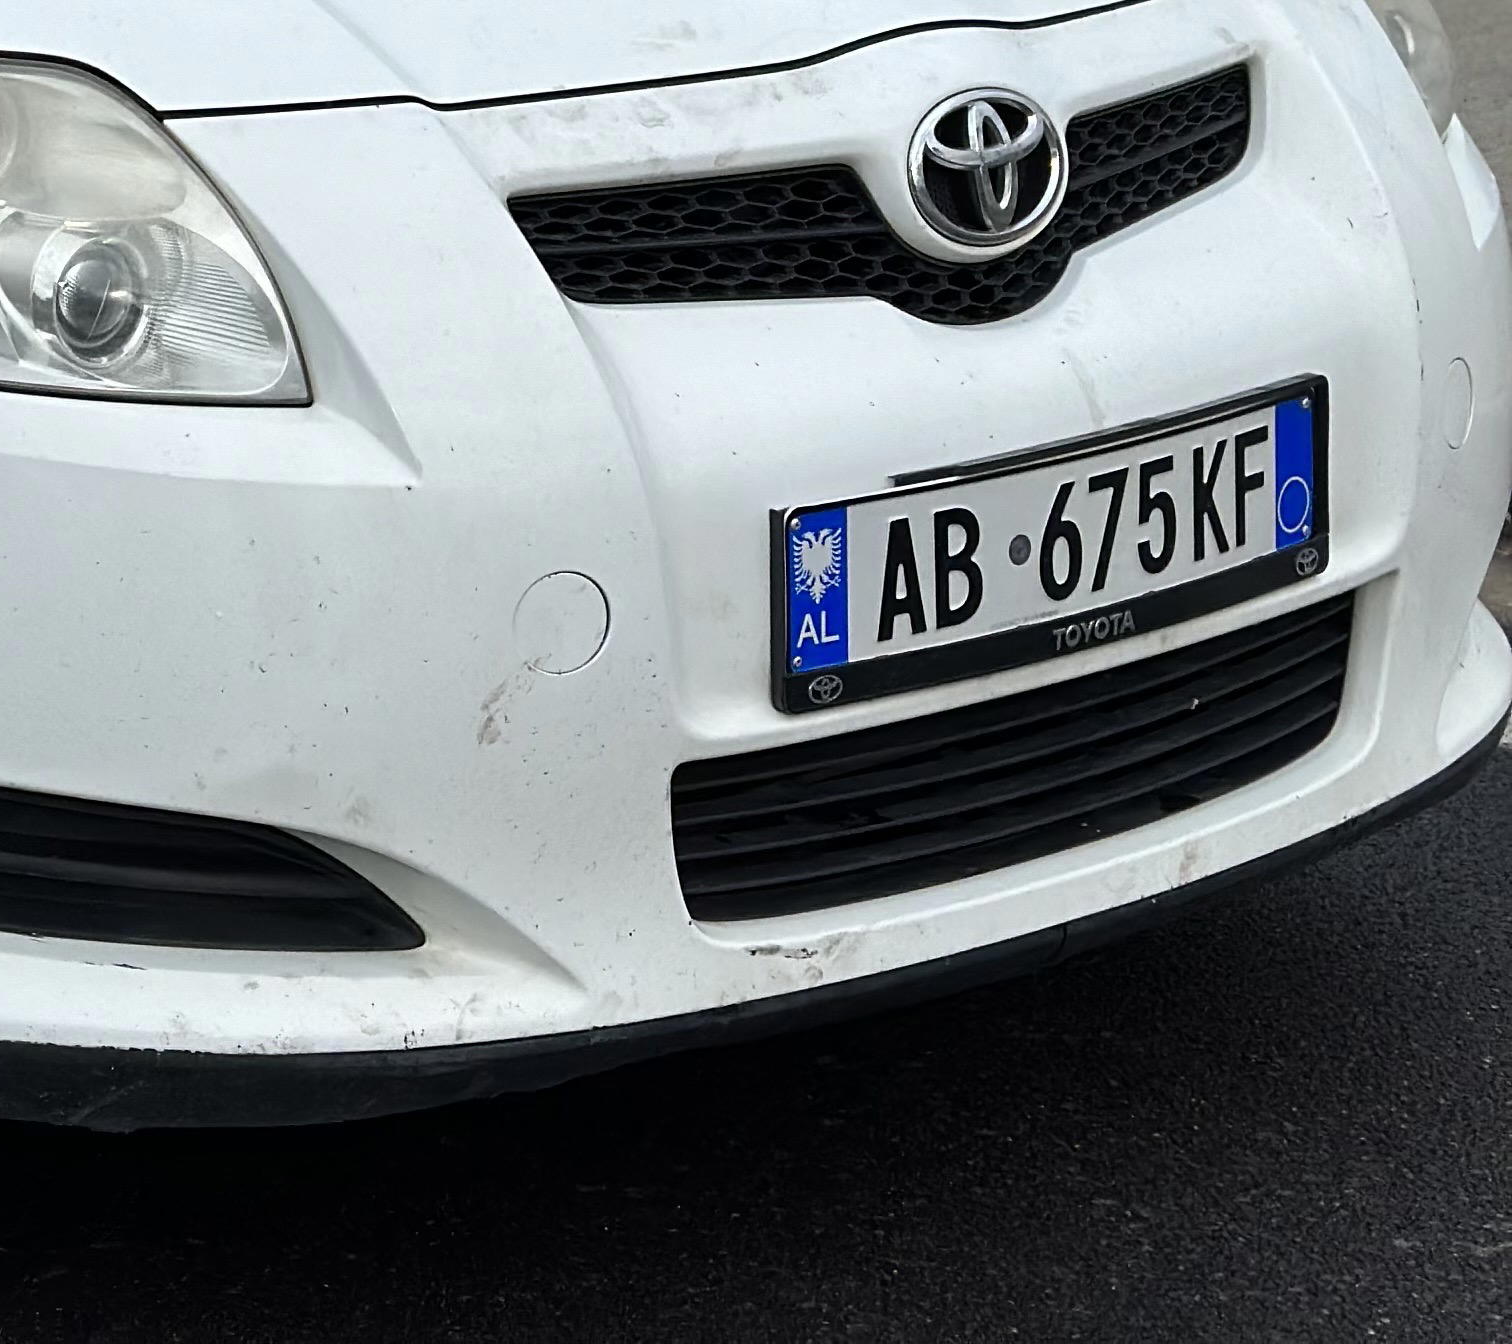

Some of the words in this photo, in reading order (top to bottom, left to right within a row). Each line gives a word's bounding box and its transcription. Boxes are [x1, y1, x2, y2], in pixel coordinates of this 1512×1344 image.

[878, 506, 984, 642] AB
[796, 610, 840, 648] AL
[1052, 610, 1136, 651] TOYOTA
